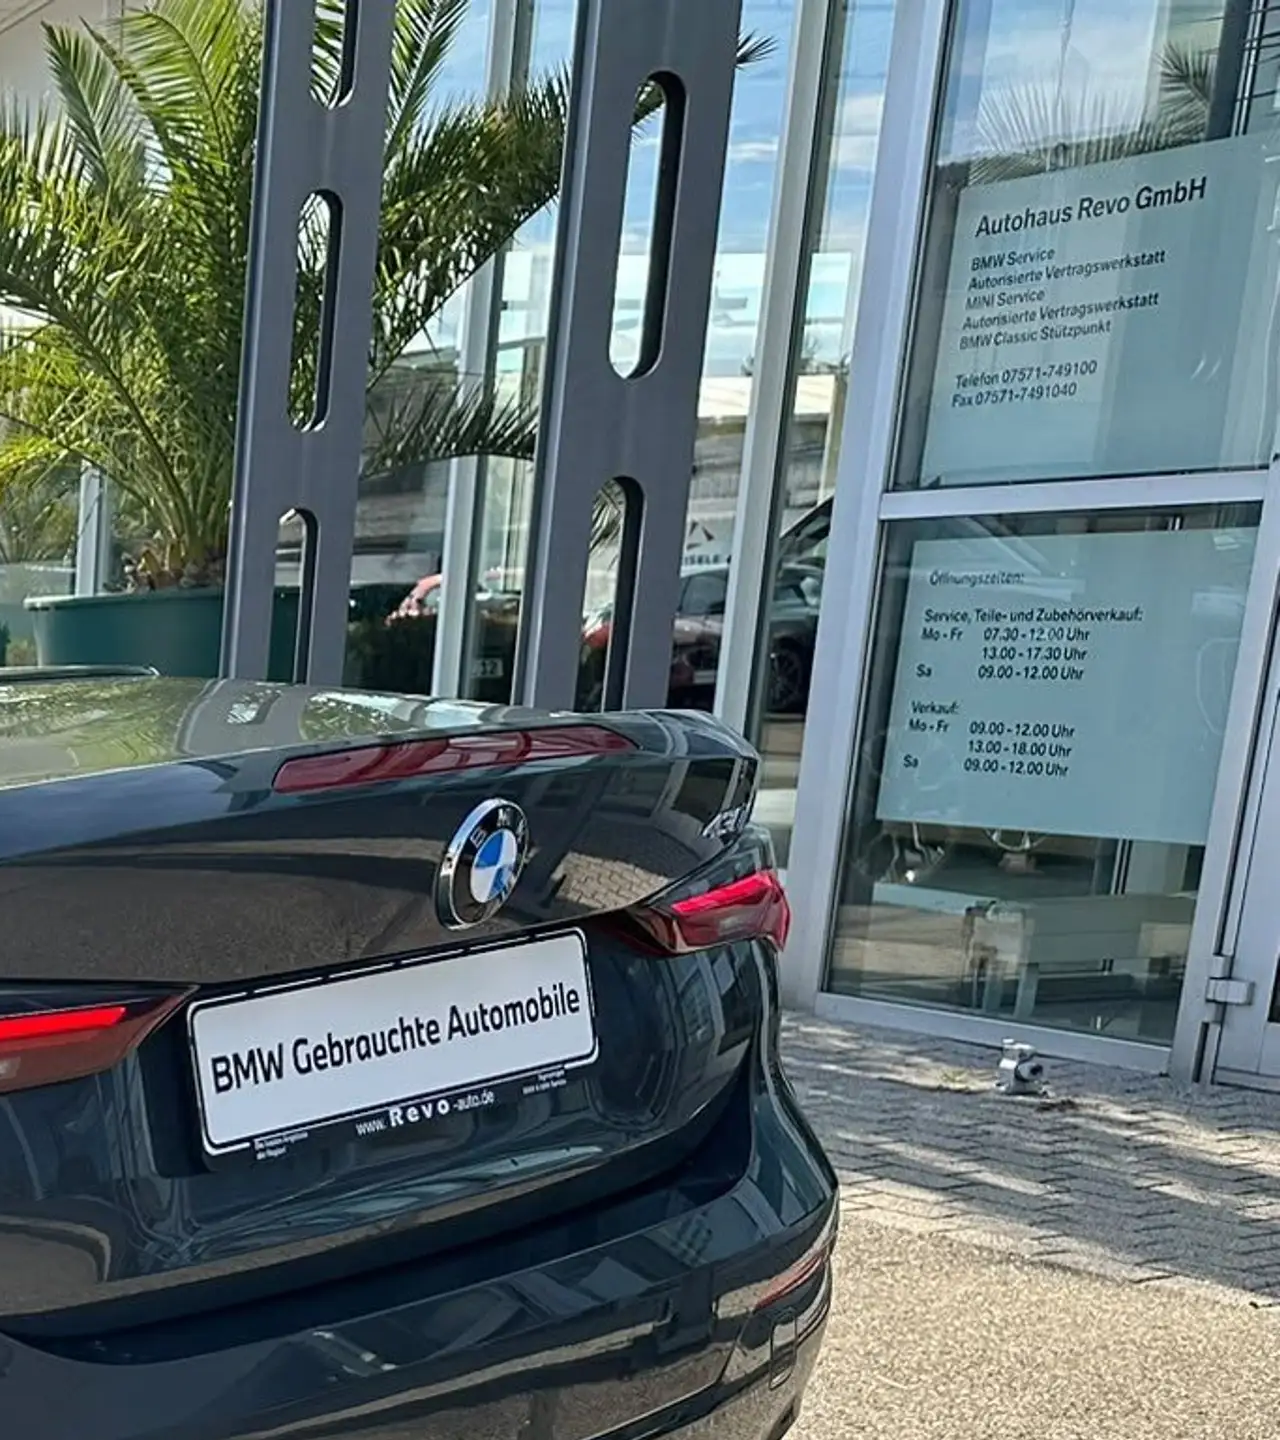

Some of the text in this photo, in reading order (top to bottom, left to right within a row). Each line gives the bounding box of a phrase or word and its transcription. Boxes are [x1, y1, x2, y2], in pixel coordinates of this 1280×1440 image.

[975, 176, 1207, 238] Autohaus Revo GmbH
[968, 250, 1166, 291] Autorisierte Vertragswerkstatt
[971, 249, 1055, 271] BMW Service
[996, 289, 1046, 307] Service
[962, 292, 1159, 331] Autorisierte Vertragswerkstatt
[959, 320, 1111, 350] BMW Classic Stützpunkt
[955, 360, 1098, 389] Telefon 07571-749100
[951, 382, 1077, 408] Fax 07571-7491040
[924, 605, 1143, 625] Service, Teile- und Zubehörverkauf:
[921, 626, 940, 641] Mo
[950, 626, 963, 640] Fr
[983, 627, 1020, 642] 07.30
[1030, 626, 1064, 642] 12.00
[1066, 626, 1090, 642] Uhr
[982, 646, 1017, 660] 13.00
[1027, 646, 1062, 661] 17.30
[1063, 646, 1088, 661] Uhr
[916, 663, 932, 678] Sa
[978, 665, 1014, 680] 09.00
[1023, 665, 1058, 680] 12.00
[1060, 665, 1084, 681] Uhr
[911, 700, 960, 715] Verkauf:
[909, 718, 928, 733] Mo
[935, 719, 950, 733] Fr
[969, 721, 1005, 736] 09.00
[1015, 723, 1050, 738] 12.00
[1051, 723, 1076, 739] Uhr
[968, 739, 1002, 755] 13.00
[1012, 742, 1047, 757] 18.00
[1048, 743, 1073, 758] Uhr
[903, 754, 919, 769] Sa
[963, 757, 999, 773] 09.00
[1009, 760, 1044, 777] 12.00
[1044, 761, 1070, 778] Uhr
[211, 982, 581, 1095] BMW Gebrauchte Automobile
[390, 1098, 451, 1128] Revo
